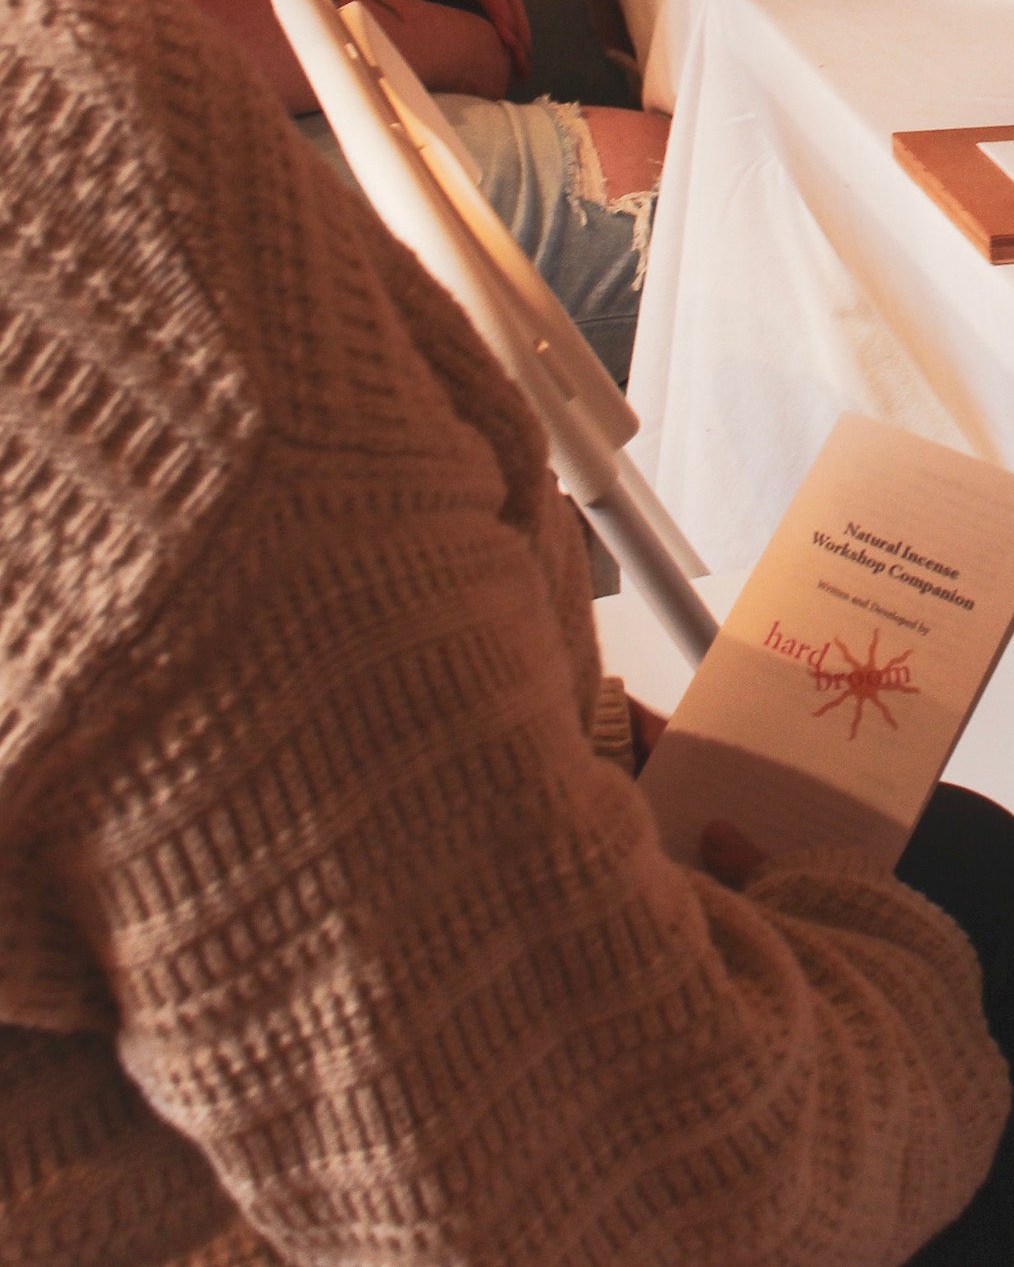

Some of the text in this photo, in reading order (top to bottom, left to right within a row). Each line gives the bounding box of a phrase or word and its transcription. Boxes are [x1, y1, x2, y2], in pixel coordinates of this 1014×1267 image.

[813, 531, 975, 611] Workshop Companion
[843, 522, 960, 580] Natural Incense
[851, 595, 870, 609] and
[869, 601, 919, 630] Developed
[917, 621, 930, 636] by
[763, 621, 831, 670] hard
